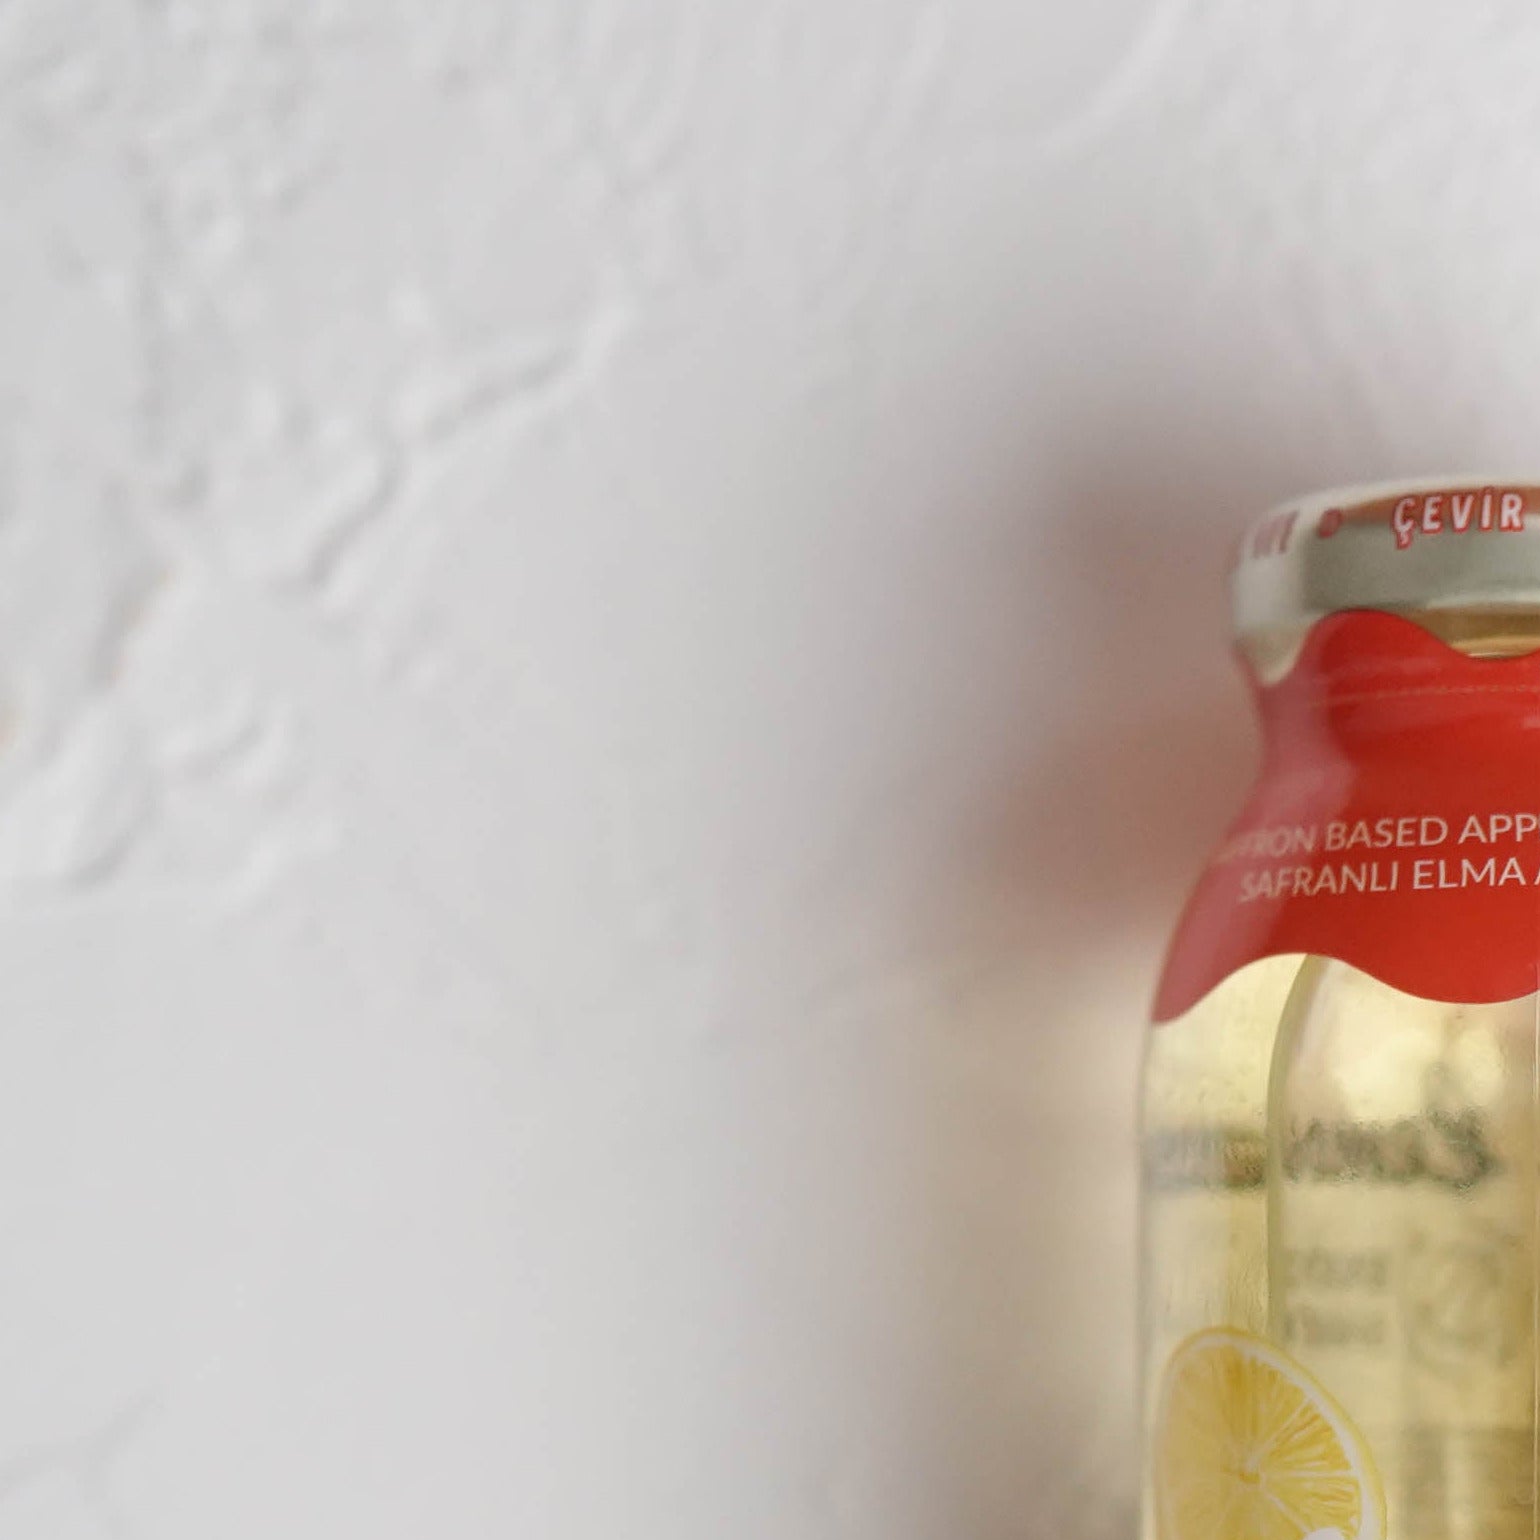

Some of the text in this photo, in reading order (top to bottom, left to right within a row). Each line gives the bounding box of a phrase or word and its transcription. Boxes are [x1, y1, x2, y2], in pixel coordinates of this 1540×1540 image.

[1393, 487, 1524, 549] ÇEVİR
[1324, 816, 1449, 851] BASED
[1239, 860, 1399, 903] SAFRANLI
[1412, 857, 1522, 890] ELMA
